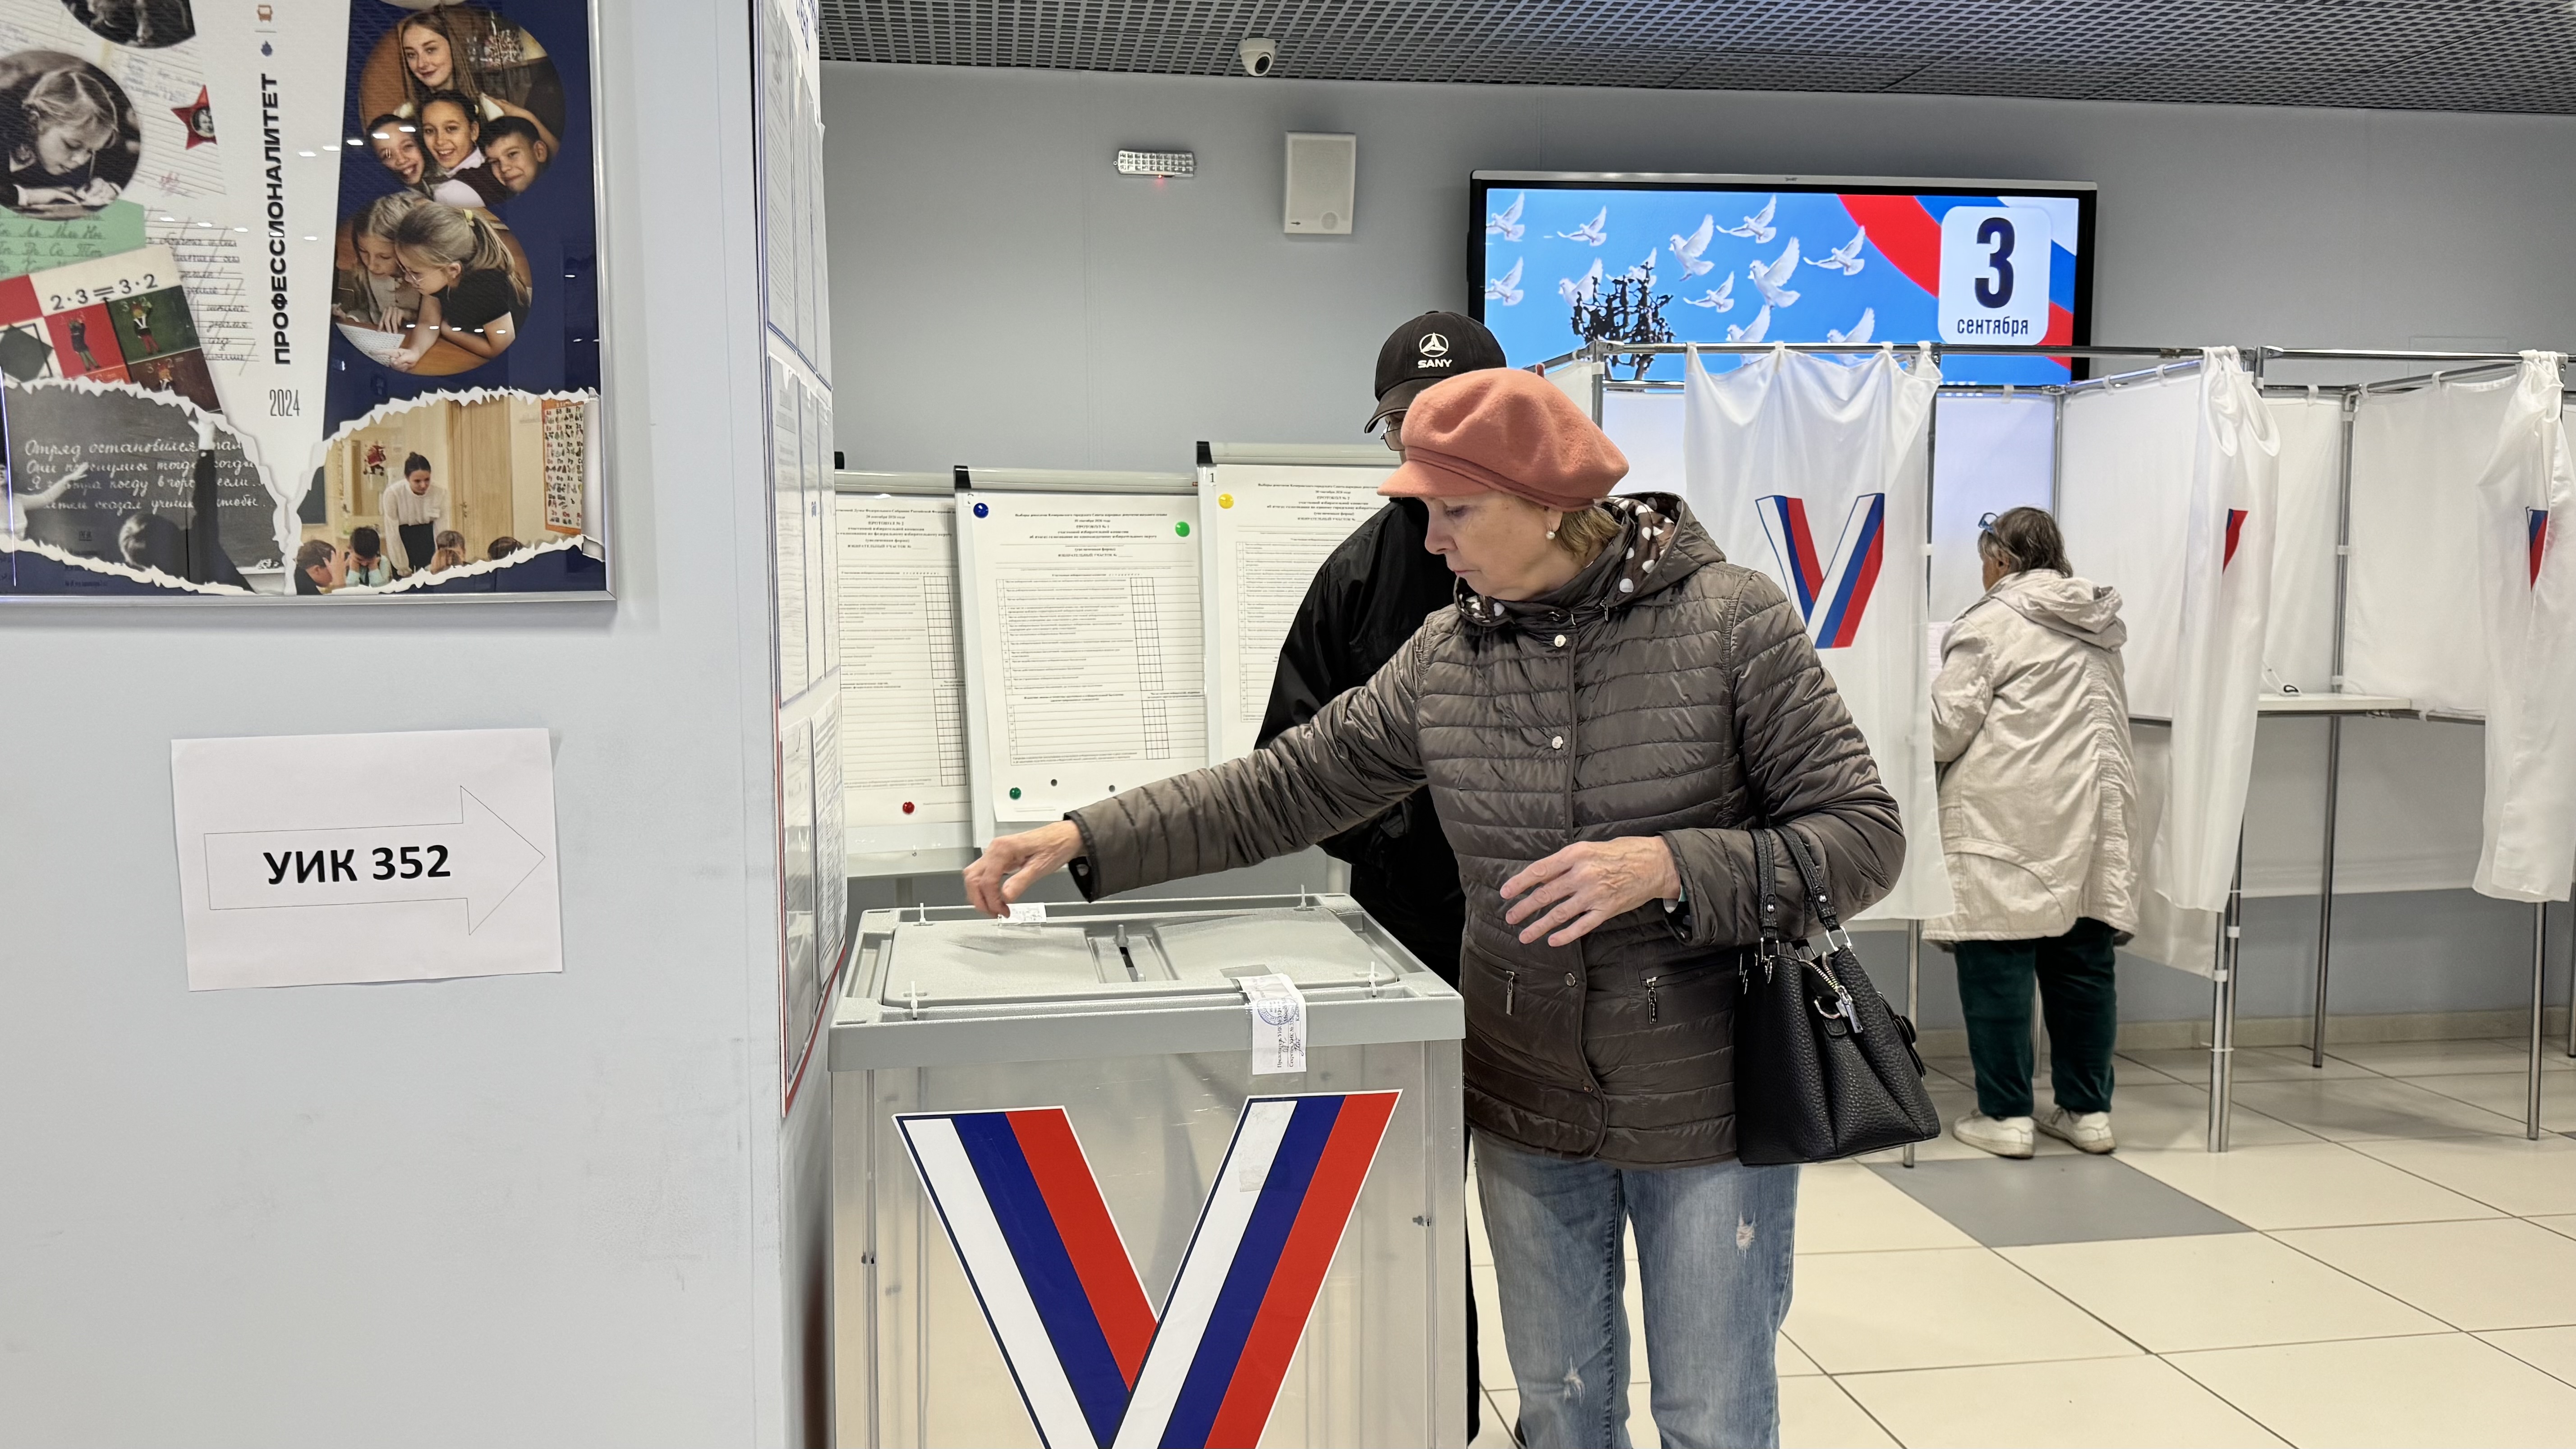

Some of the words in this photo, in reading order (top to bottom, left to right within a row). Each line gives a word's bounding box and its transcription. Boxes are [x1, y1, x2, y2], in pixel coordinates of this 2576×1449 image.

[261, 74, 291, 365] ПРОФЕССИОНАЛИТЕТ
[1974, 217, 2015, 308] 3
[1957, 316, 2029, 337] сентября
[1417, 359, 1453, 368] SANY
[270, 389, 300, 416] 2024
[167, 477, 196, 495] горо
[263, 849, 358, 885] УИК
[372, 844, 451, 880] 352
